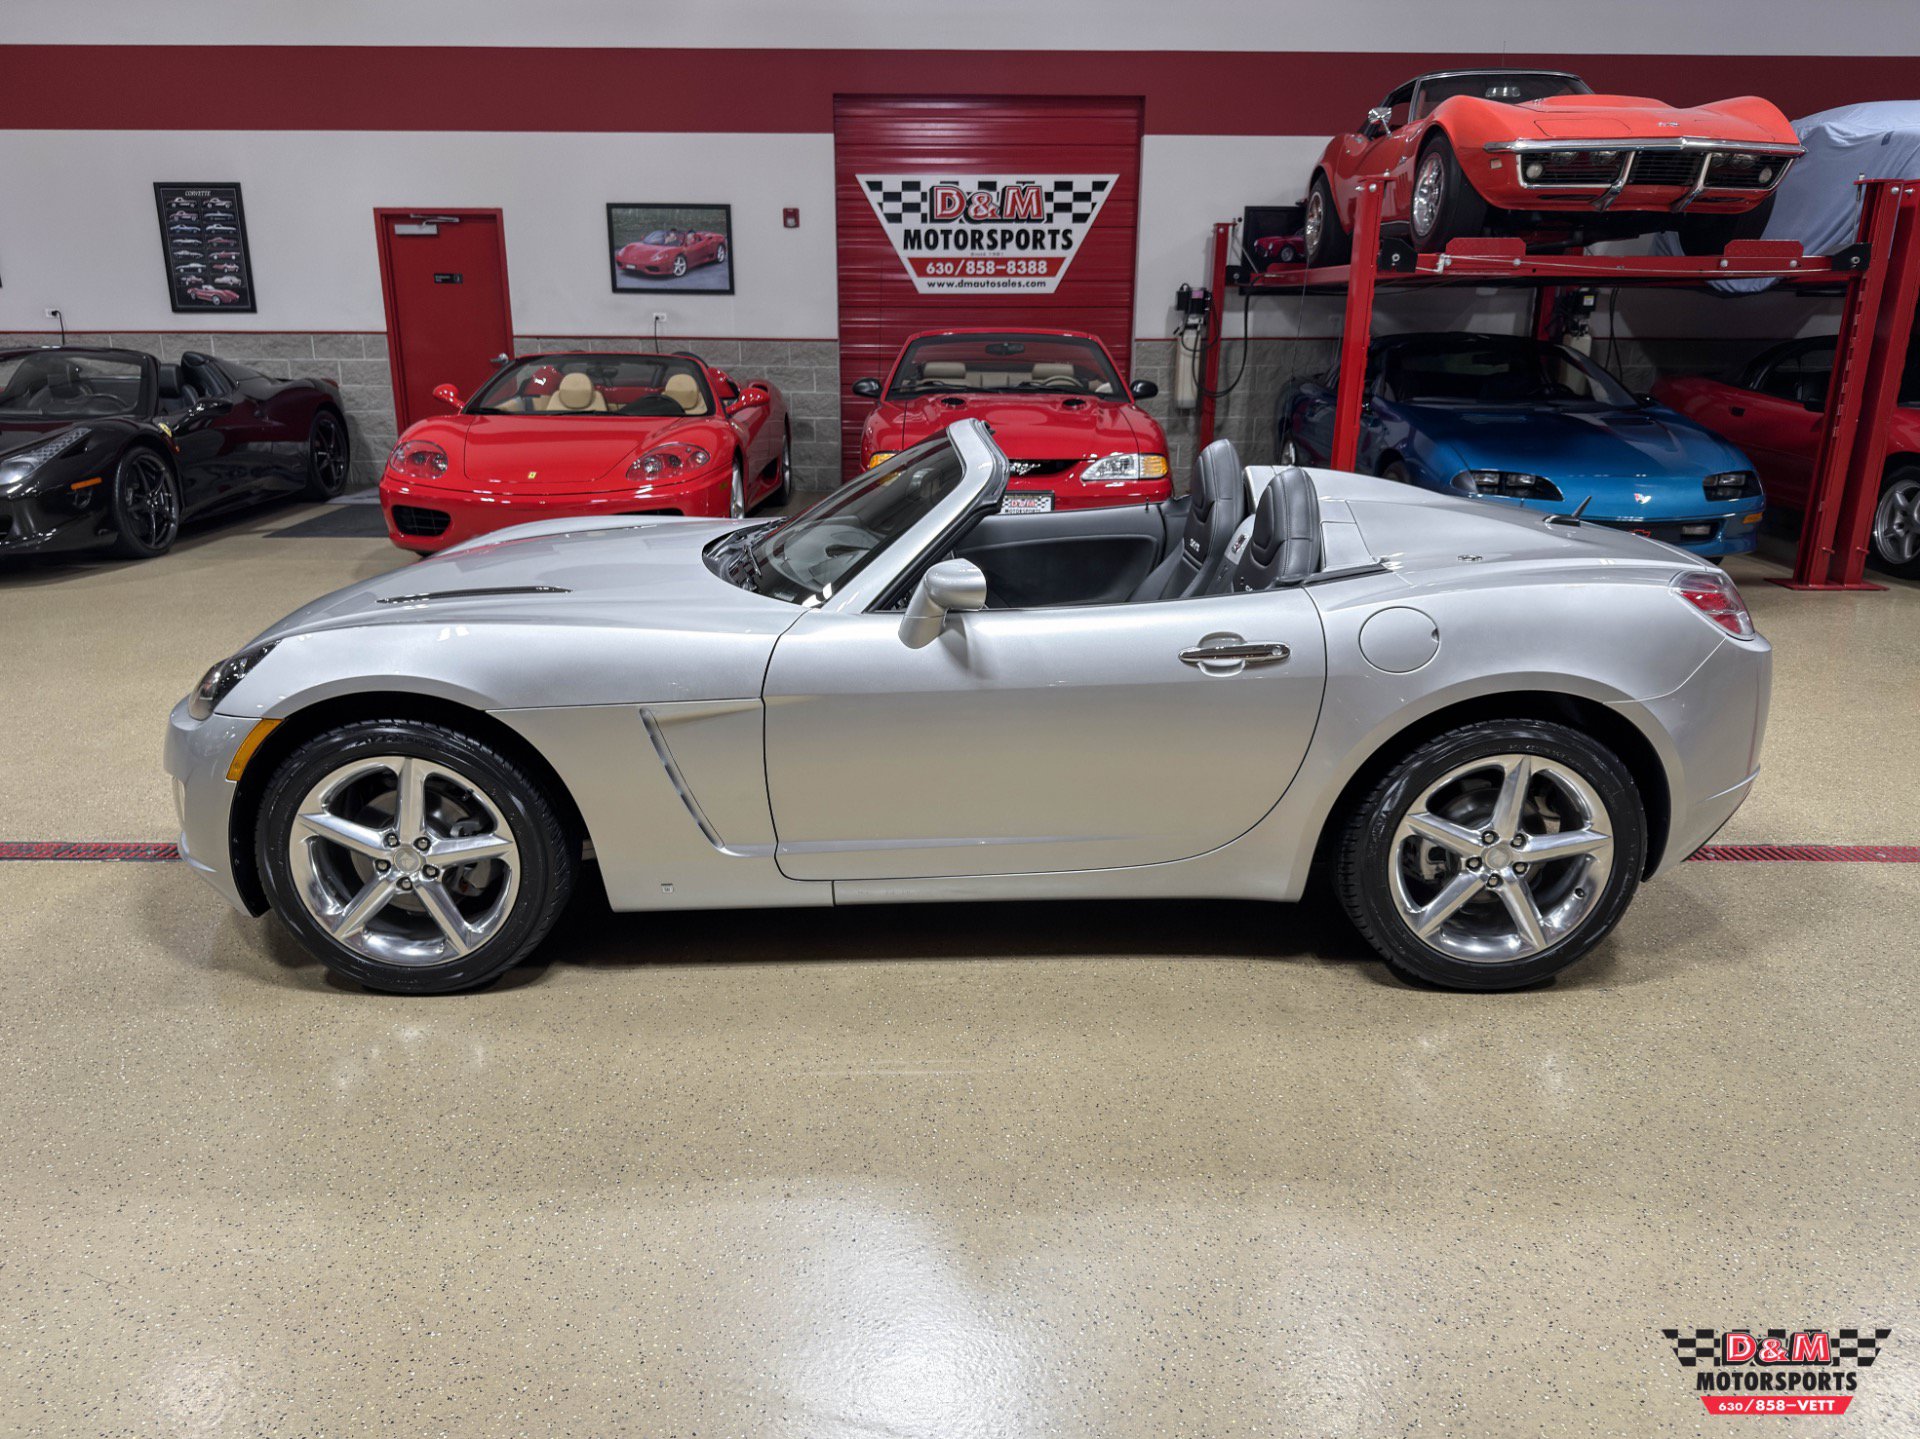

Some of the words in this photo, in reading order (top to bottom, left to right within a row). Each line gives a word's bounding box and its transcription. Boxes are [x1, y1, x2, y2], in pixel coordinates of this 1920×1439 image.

[932, 185, 1045, 222] D&M
[903, 229, 1073, 250] MOTORSPORTS
[926, 259, 1048, 276] 630/858-8388
[927, 279, 1046, 289] www.dmautosales.com
